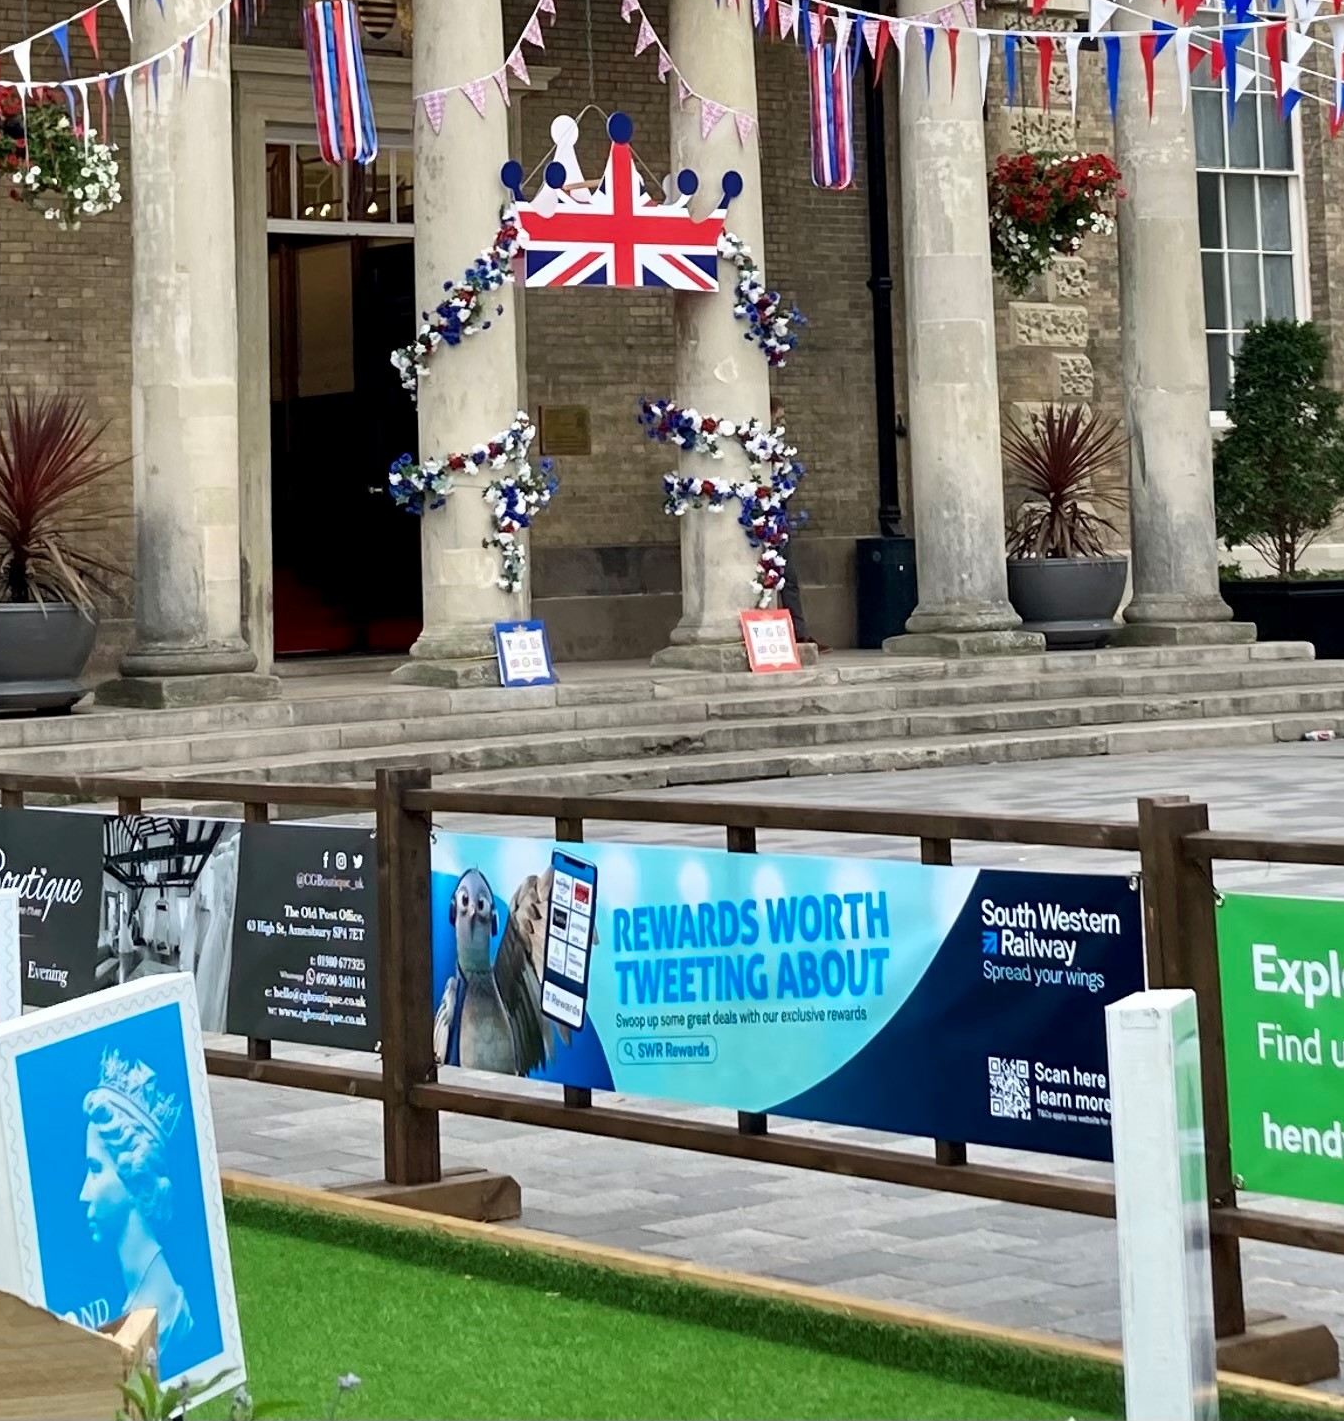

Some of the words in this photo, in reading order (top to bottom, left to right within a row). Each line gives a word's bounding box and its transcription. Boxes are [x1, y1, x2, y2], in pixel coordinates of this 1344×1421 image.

[284, 904, 299, 918] The
[301, 906, 317, 920] Old
[318, 907, 338, 921] Post
[613, 898, 760, 953] REWARDS
[765, 891, 890, 944] WORTH
[981, 898, 1037, 929] South
[1038, 902, 1121, 935] Western
[257, 919, 275, 937] High
[288, 923, 332, 942] Amesbury
[332, 926, 347, 940] SP4
[348, 927, 365, 941] 7ET
[1001, 929, 1077, 966] Railway
[27, 960, 69, 988] Evening
[614, 953, 769, 1005] TWEETING
[776, 947, 890, 999] ABOUT
[983, 960, 1031, 983] Spread
[1033, 967, 1063, 987] your
[1065, 967, 1105, 993] wings
[616, 1012, 645, 1029] Swoop
[647, 1015, 658, 1030] up
[660, 1012, 685, 1026] some
[687, 1012, 711, 1030] great
[713, 1009, 738, 1026] deals
[740, 1009, 760, 1024] with
[762, 1012, 779, 1024] our
[780, 1006, 825, 1023] exclusive
[826, 1005, 867, 1022] rewards
[638, 1043, 662, 1058] SWR
[665, 1042, 710, 1058] Rewards
[1256, 1021, 1323, 1066] Find
[1034, 1061, 1071, 1085] Scan
[1073, 1066, 1107, 1089] here
[1036, 1084, 1072, 1108] learn
[1075, 1094, 1112, 1114] more
